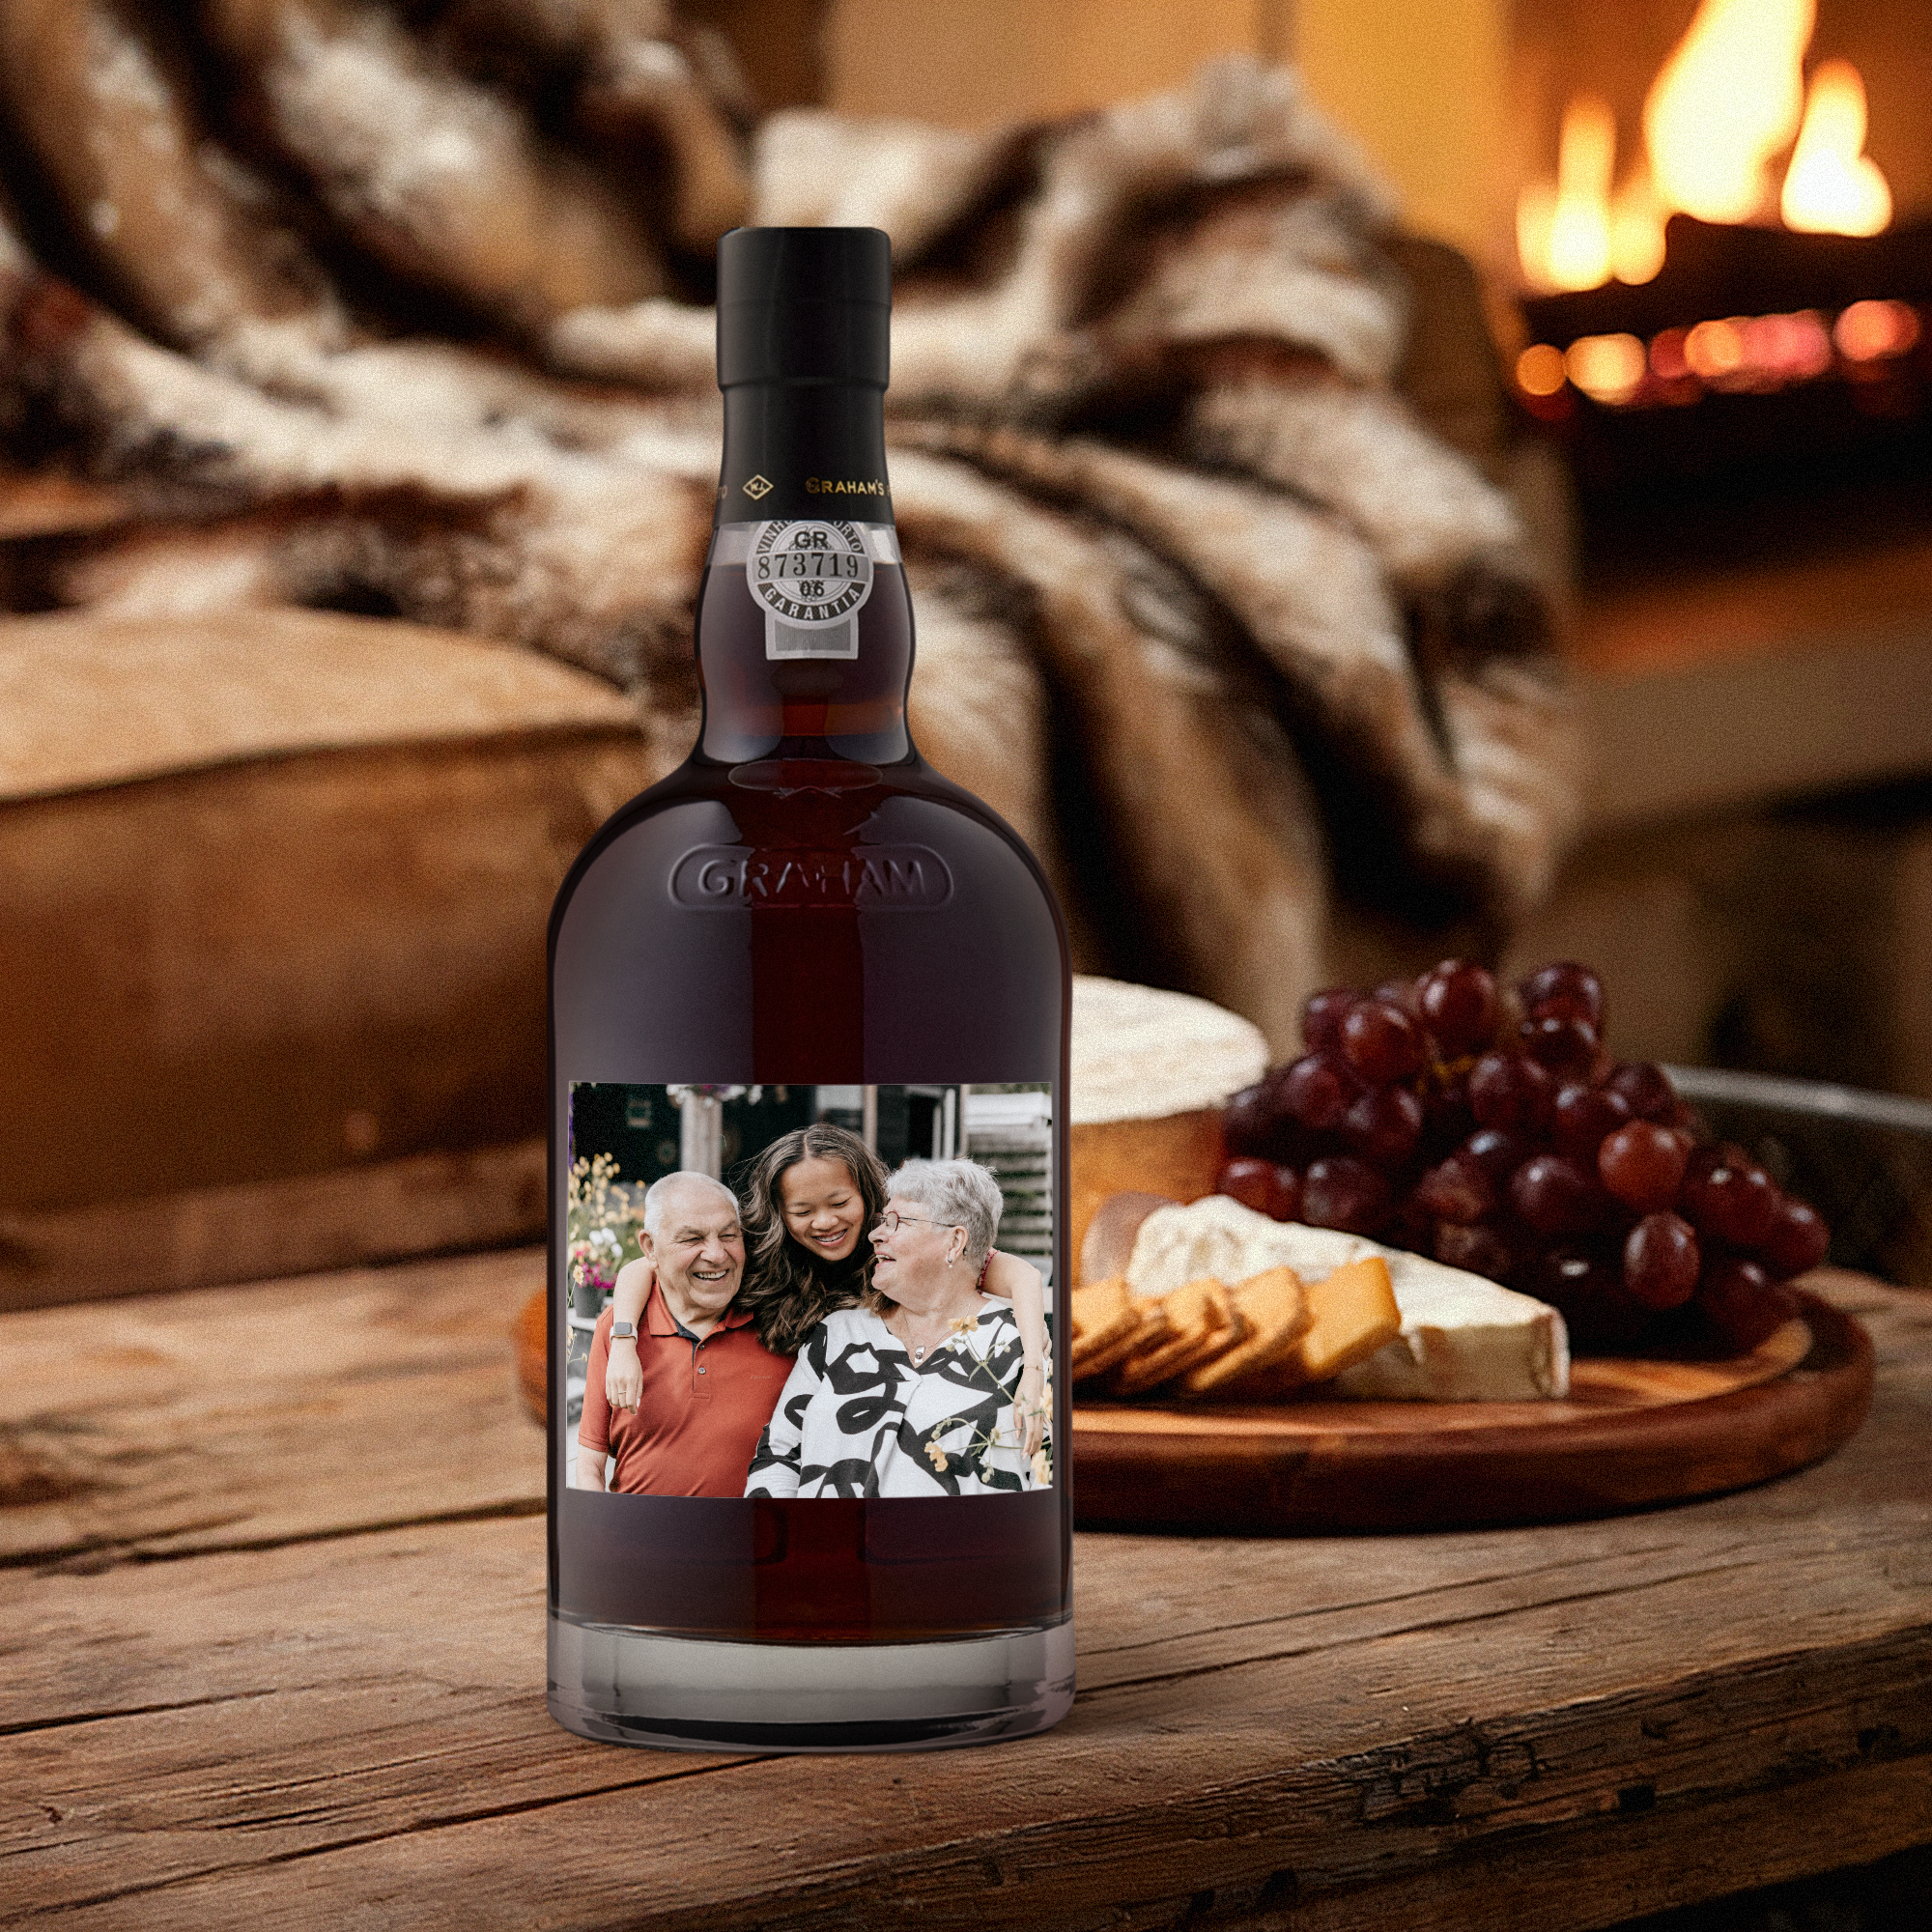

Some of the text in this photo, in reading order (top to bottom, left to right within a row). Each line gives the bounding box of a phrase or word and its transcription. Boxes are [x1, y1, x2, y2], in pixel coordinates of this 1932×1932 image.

[806, 477, 885, 497] GRAHAM'S
[794, 530, 829, 550] GR
[833, 520, 862, 552] ORTO
[757, 552, 859, 580] 873719
[799, 581, 825, 597] 06
[764, 587, 861, 620] GARANTIA
[696, 859, 926, 897] GRAHAM
